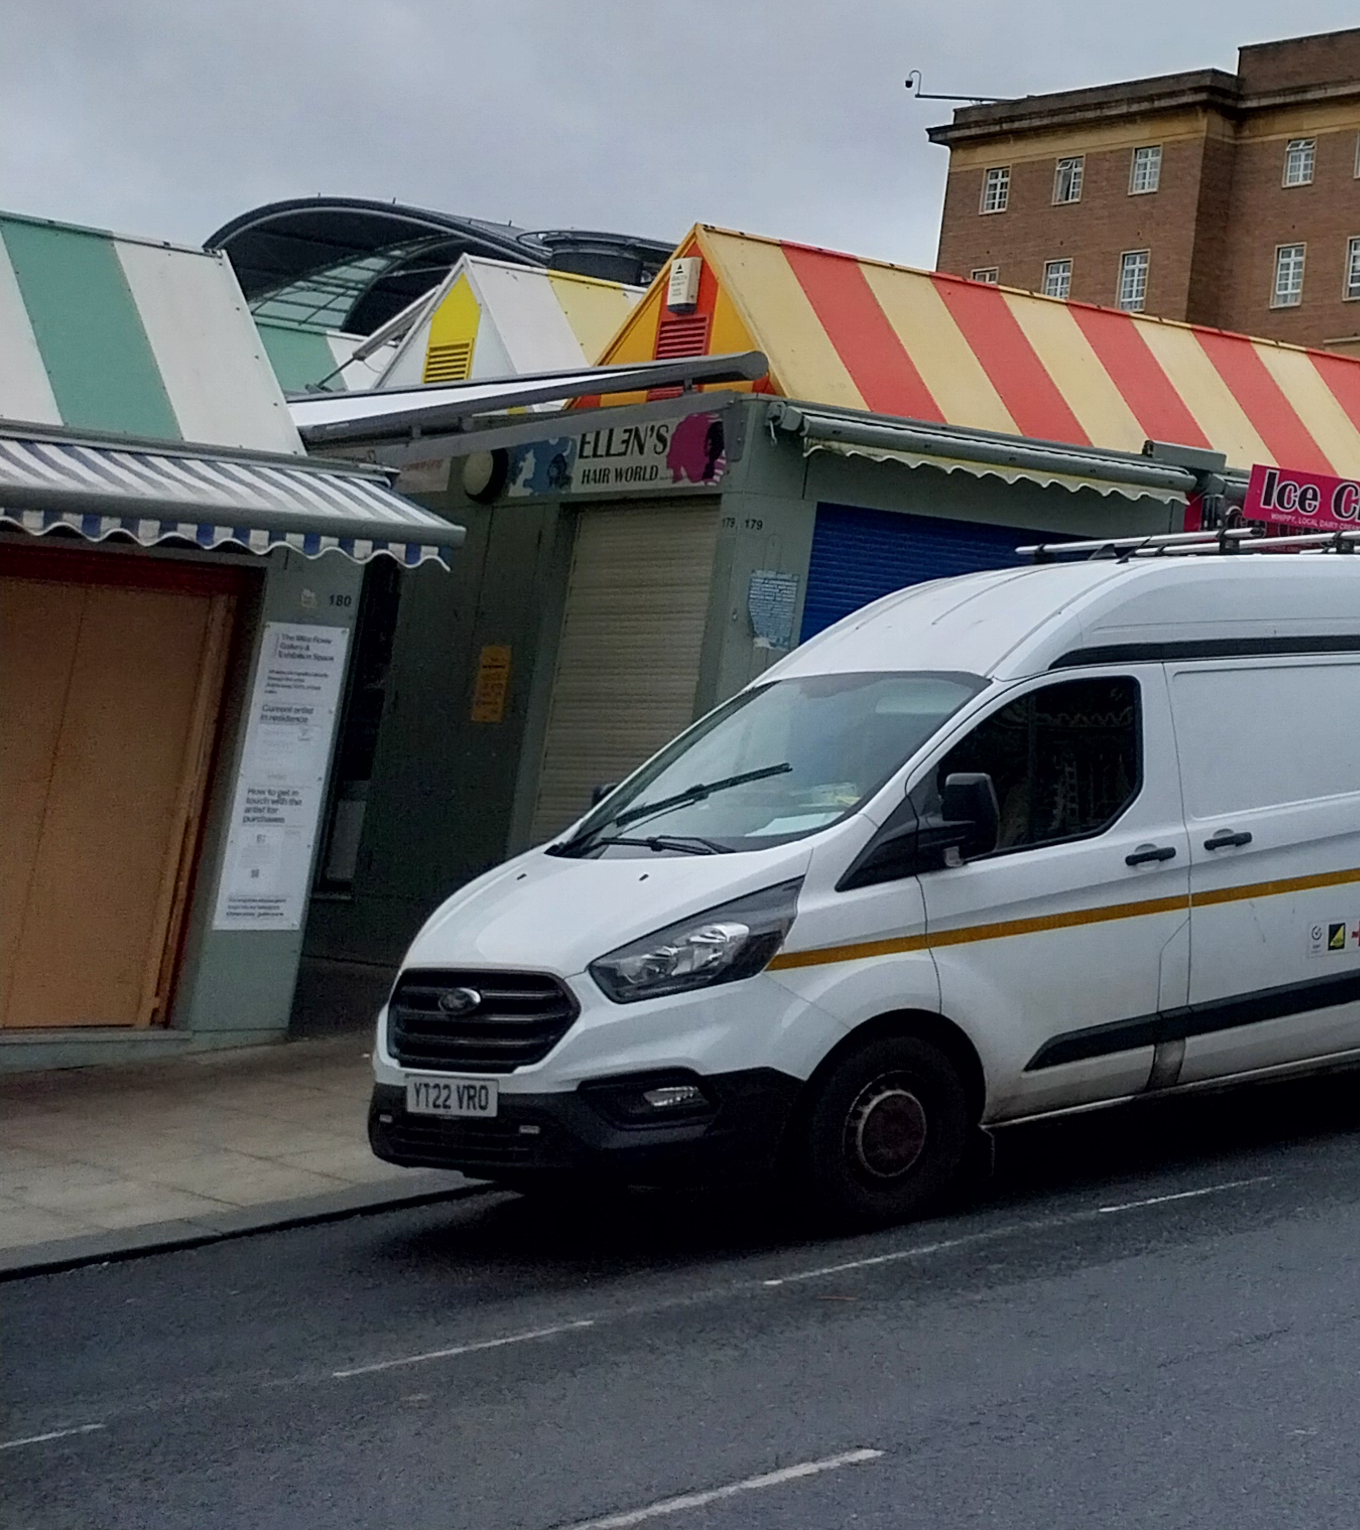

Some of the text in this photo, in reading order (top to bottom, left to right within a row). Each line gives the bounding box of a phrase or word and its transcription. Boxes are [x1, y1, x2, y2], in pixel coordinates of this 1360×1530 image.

[581, 465, 659, 485] HAIR WORLD
[1260, 469, 1321, 515] Ice
[744, 518, 763, 531] 179
[1298, 517, 1318, 527] LOCAL
[1319, 520, 1339, 530] DAIRY
[329, 594, 352, 607] 180
[262, 704, 293, 713] Current
[247, 788, 266, 796] How
[267, 789, 276, 797] to
[277, 789, 291, 799] get
[271, 798, 287, 806] with
[244, 806, 266, 814] artist
[414, 1082, 489, 1111] YT22 VRO
